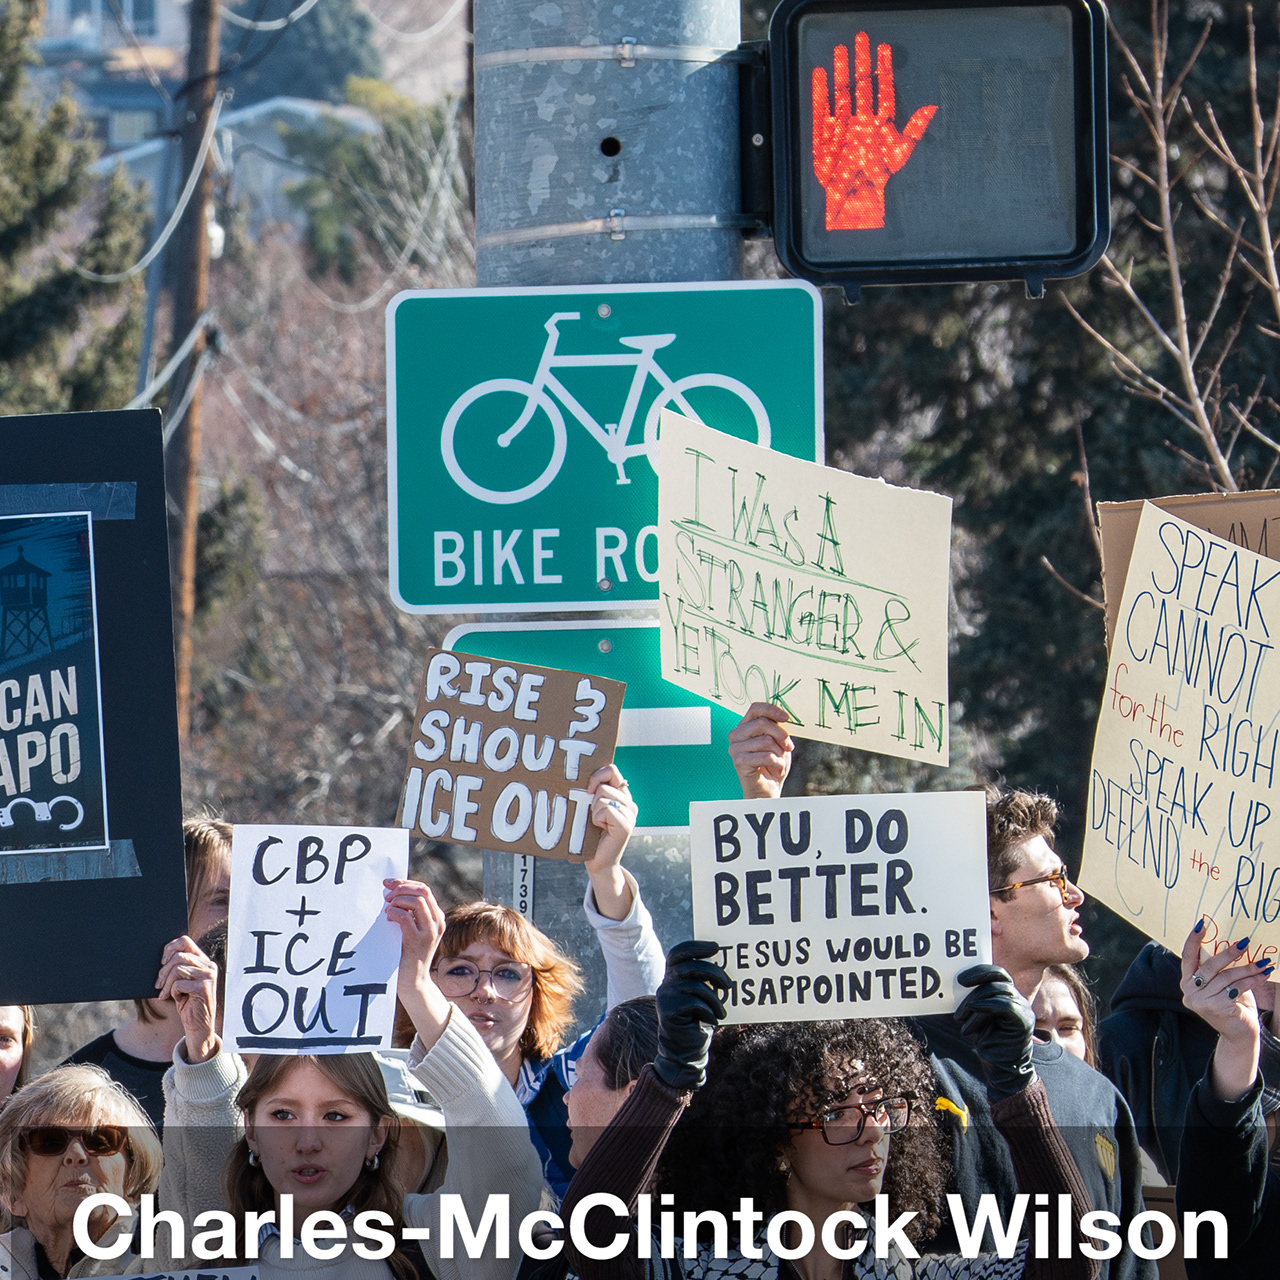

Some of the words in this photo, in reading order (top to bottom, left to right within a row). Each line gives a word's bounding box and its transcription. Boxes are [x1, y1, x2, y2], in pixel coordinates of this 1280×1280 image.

[681, 447, 716, 532] I
[728, 466, 805, 566] WAS
[811, 492, 847, 577] A
[433, 527, 563, 587] BIKE
[1151, 521, 1280, 638] SPEAK
[676, 531, 867, 660] STRANGER
[873, 597, 922, 673] &
[425, 652, 546, 723] RISE
[1126, 591, 1275, 713] CANNOT
[815, 678, 881, 735] ME
[893, 690, 946, 753] IN
[1110, 662, 1144, 723] for
[1147, 692, 1184, 748] the
[413, 709, 597, 781] SHOUT
[401, 767, 483, 842] ICE
[491, 782, 595, 856] OUT
[1092, 769, 1180, 889] DEFEND
[1190, 849, 1221, 881] the
[1129, 738, 1214, 836] SPEAK
[1228, 791, 1271, 851] UP
[252, 833, 372, 886] CBP
[713, 810, 822, 863] BYU,
[845, 809, 909, 855] DO
[285, 896, 321, 927] +
[714, 859, 928, 926] BETTER.
[243, 931, 356, 977] ICE
[714, 937, 811, 970] JESUS
[826, 932, 931, 963] WOULD
[945, 928, 978, 957] BE
[1202, 913, 1280, 967] Prve
[241, 982, 388, 1037] OUT
